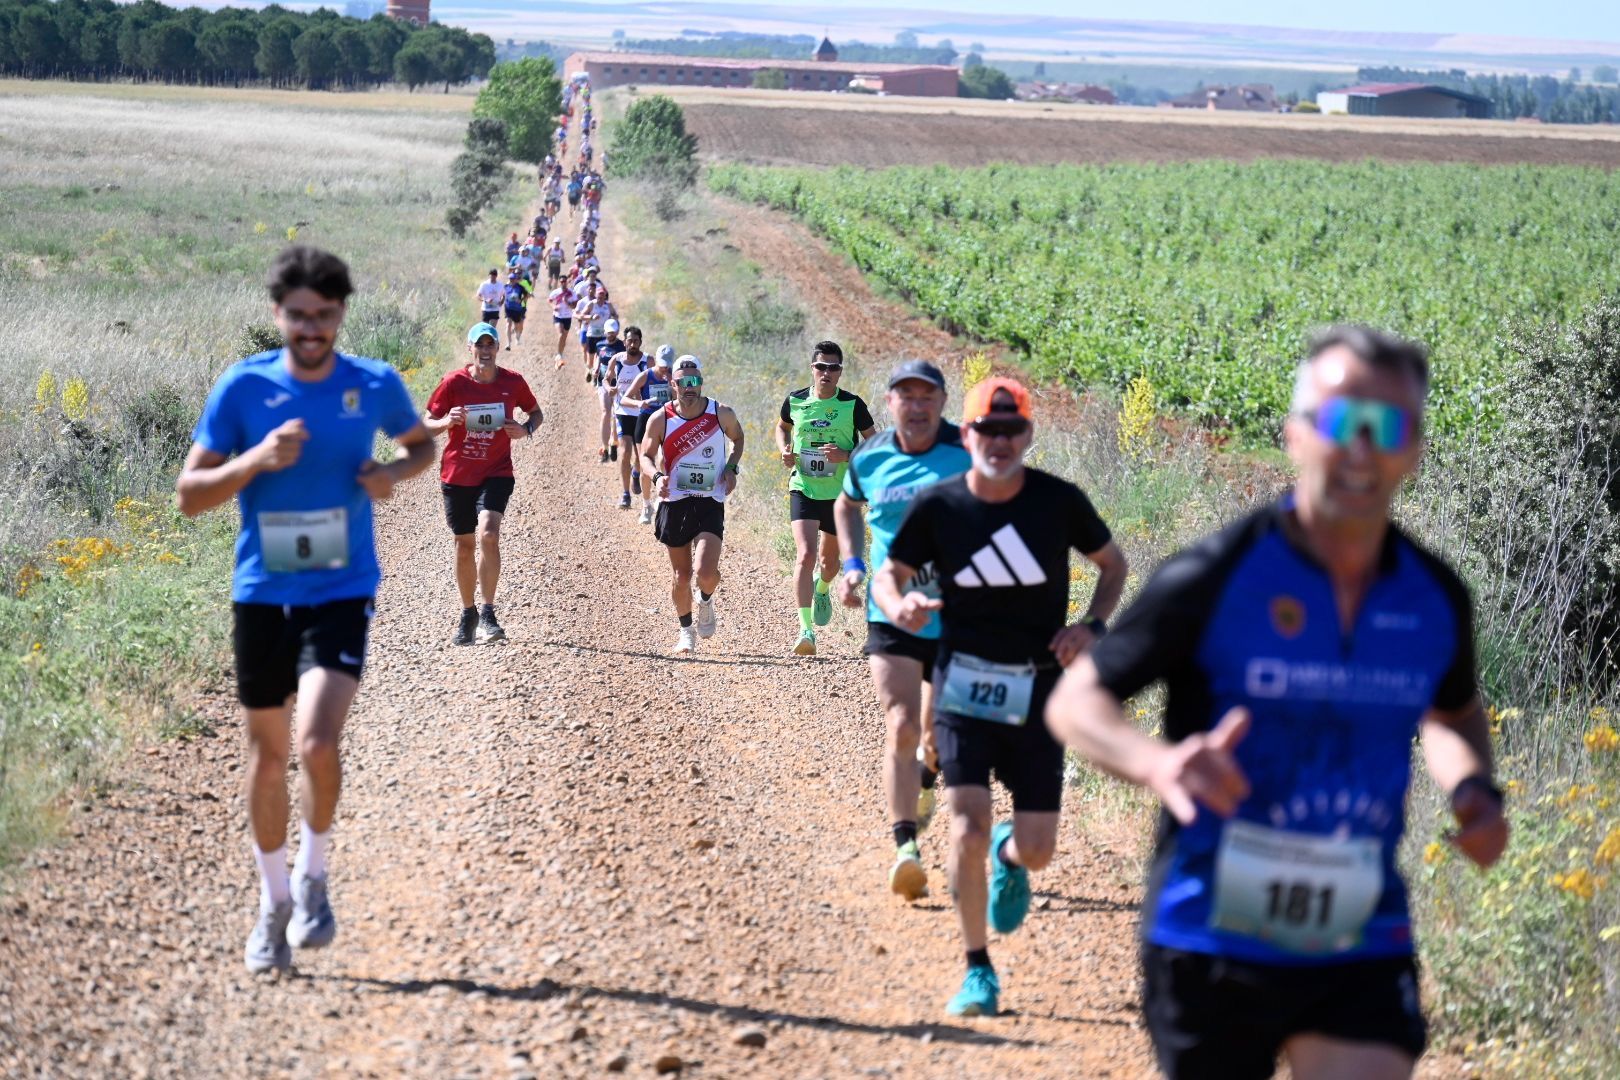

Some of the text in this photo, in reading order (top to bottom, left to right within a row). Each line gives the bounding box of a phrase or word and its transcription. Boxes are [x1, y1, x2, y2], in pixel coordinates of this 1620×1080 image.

[478, 414, 492, 425] 40
[673, 418, 709, 448] LA DESPENSA
[687, 431, 709, 448] FER
[810, 460, 825, 472] 90
[690, 472, 704, 485] 33
[296, 534, 311, 560] 8
[969, 681, 1008, 708] 129
[1266, 877, 1338, 928] 181
